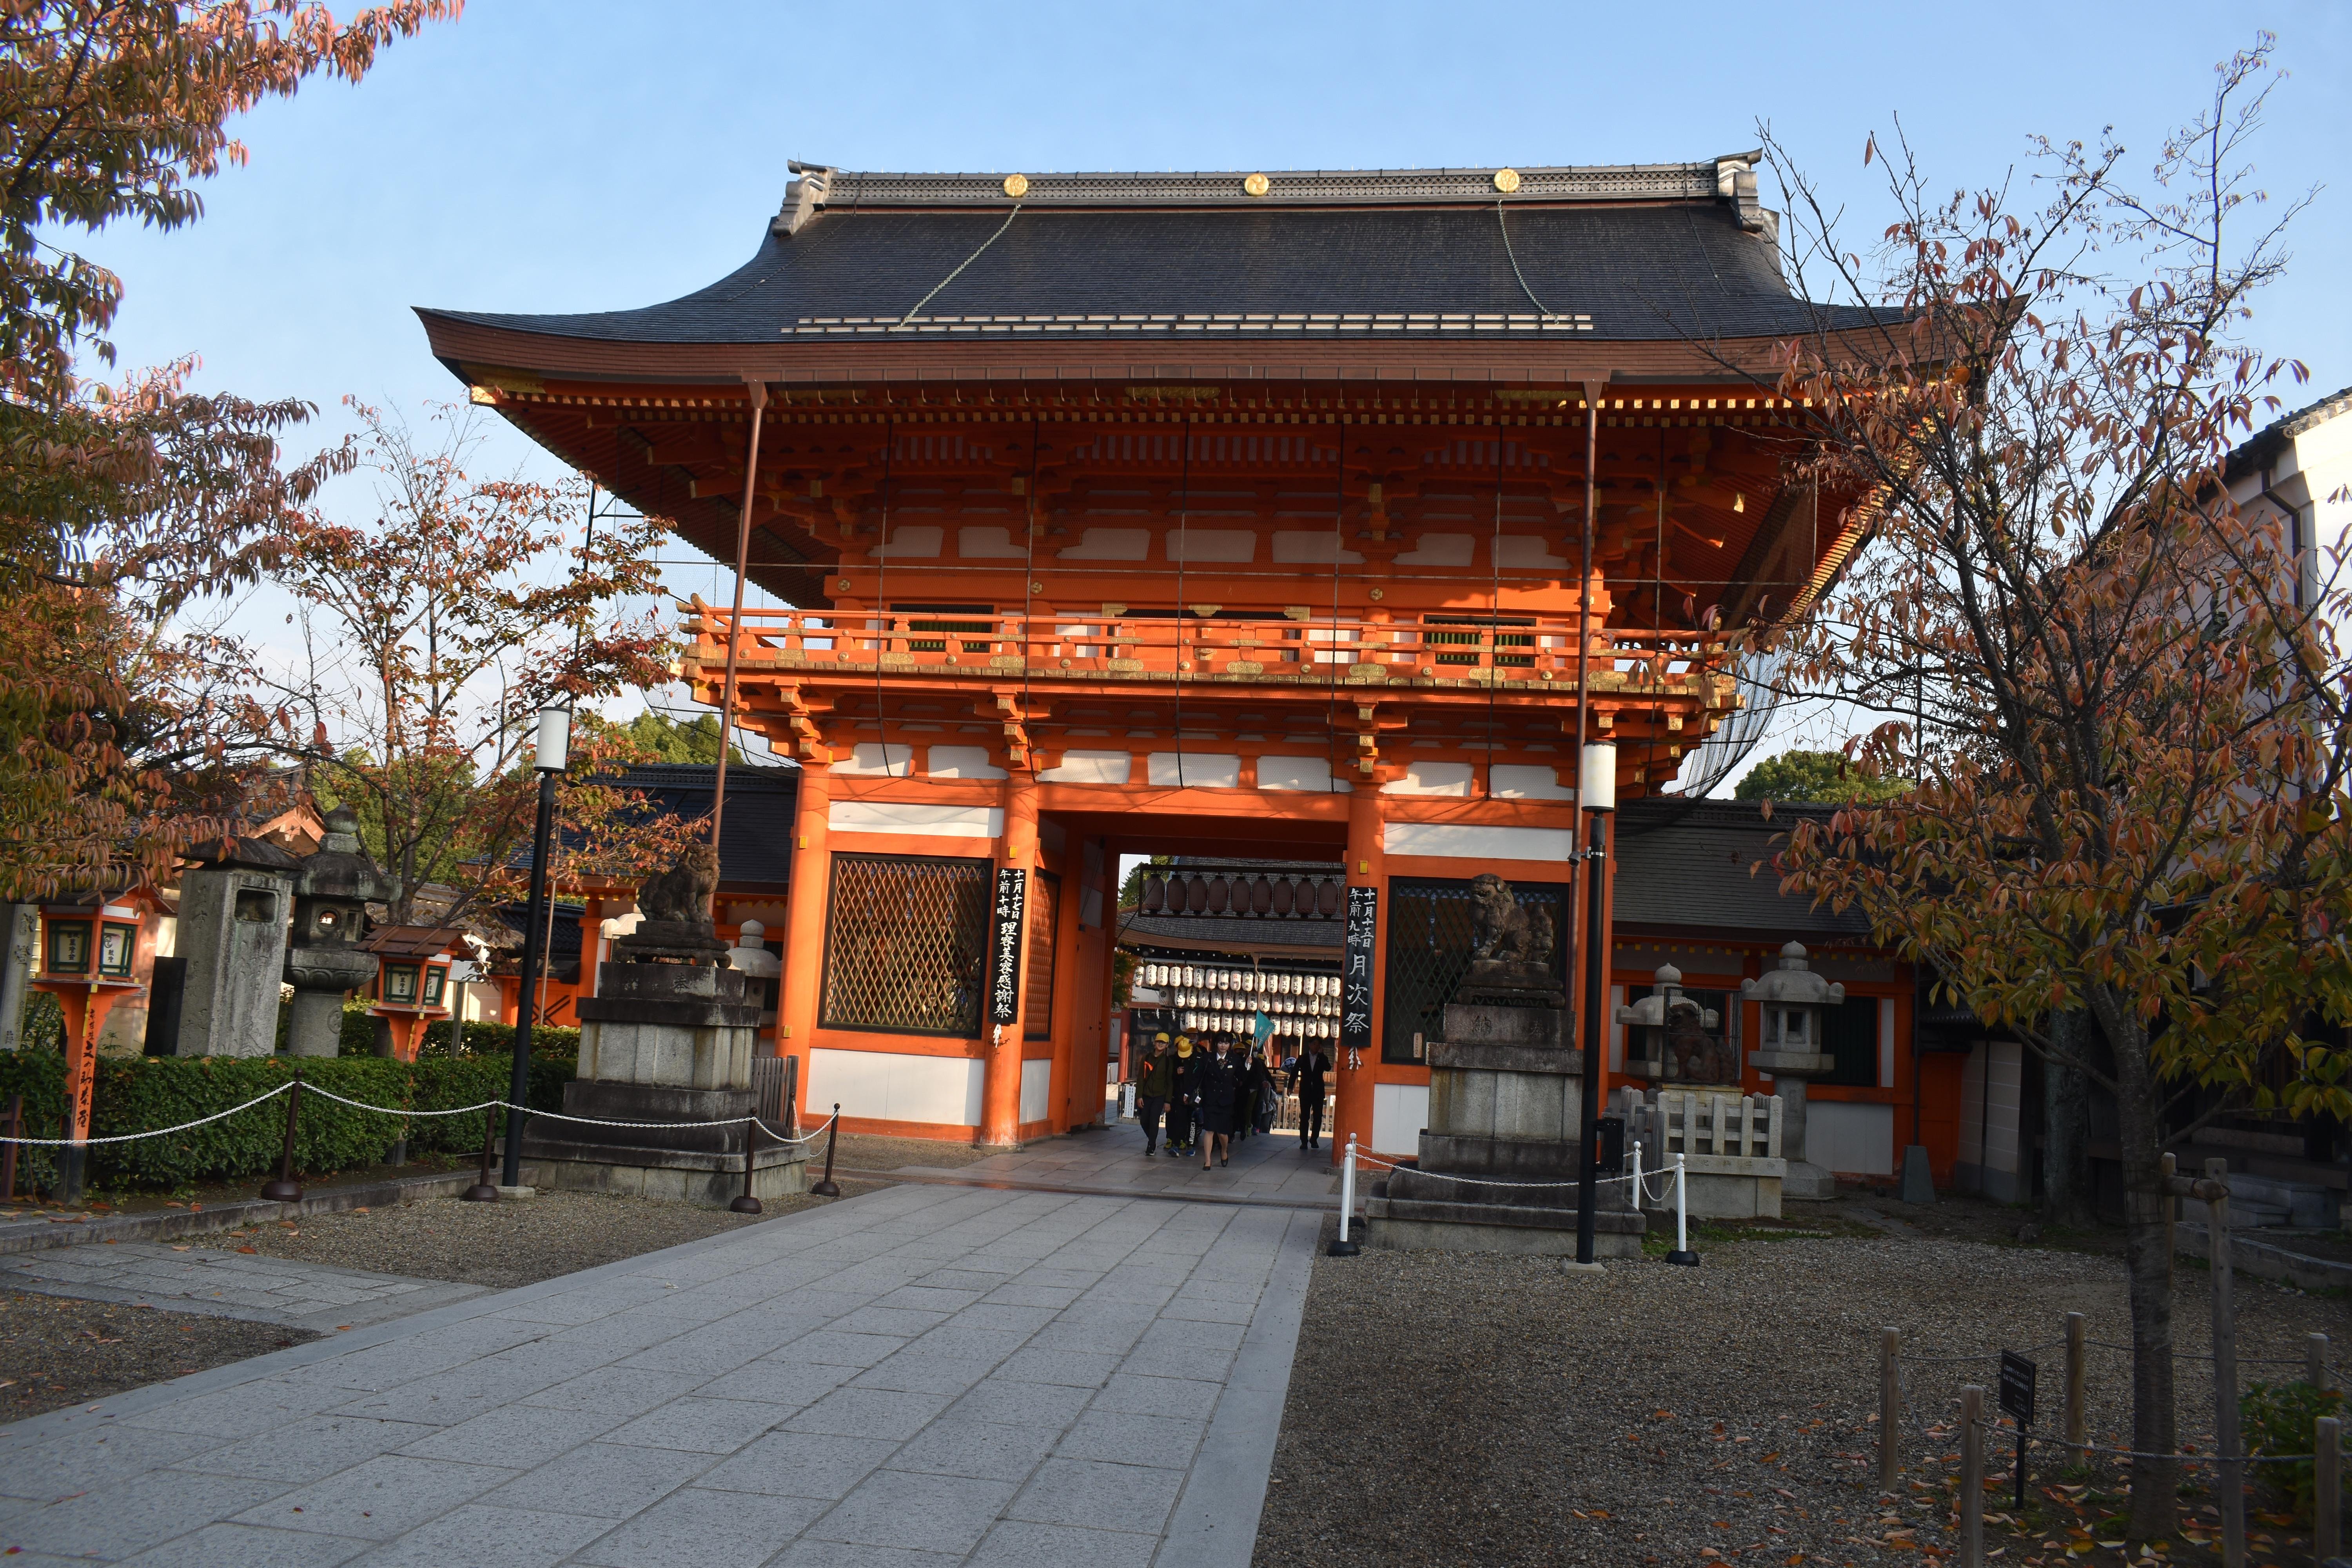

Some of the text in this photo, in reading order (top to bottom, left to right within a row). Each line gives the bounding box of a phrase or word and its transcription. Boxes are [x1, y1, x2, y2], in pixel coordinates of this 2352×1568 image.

[997, 869, 1011, 917] 午前十時
[1012, 869, 1024, 919] 十一月十七日
[1347, 887, 1363, 947] 午前九時
[1360, 887, 1376, 948] 十一月十五日
[994, 922, 1017, 1018] 理容美容感謝祭
[1343, 954, 1369, 1034] 月次祭
